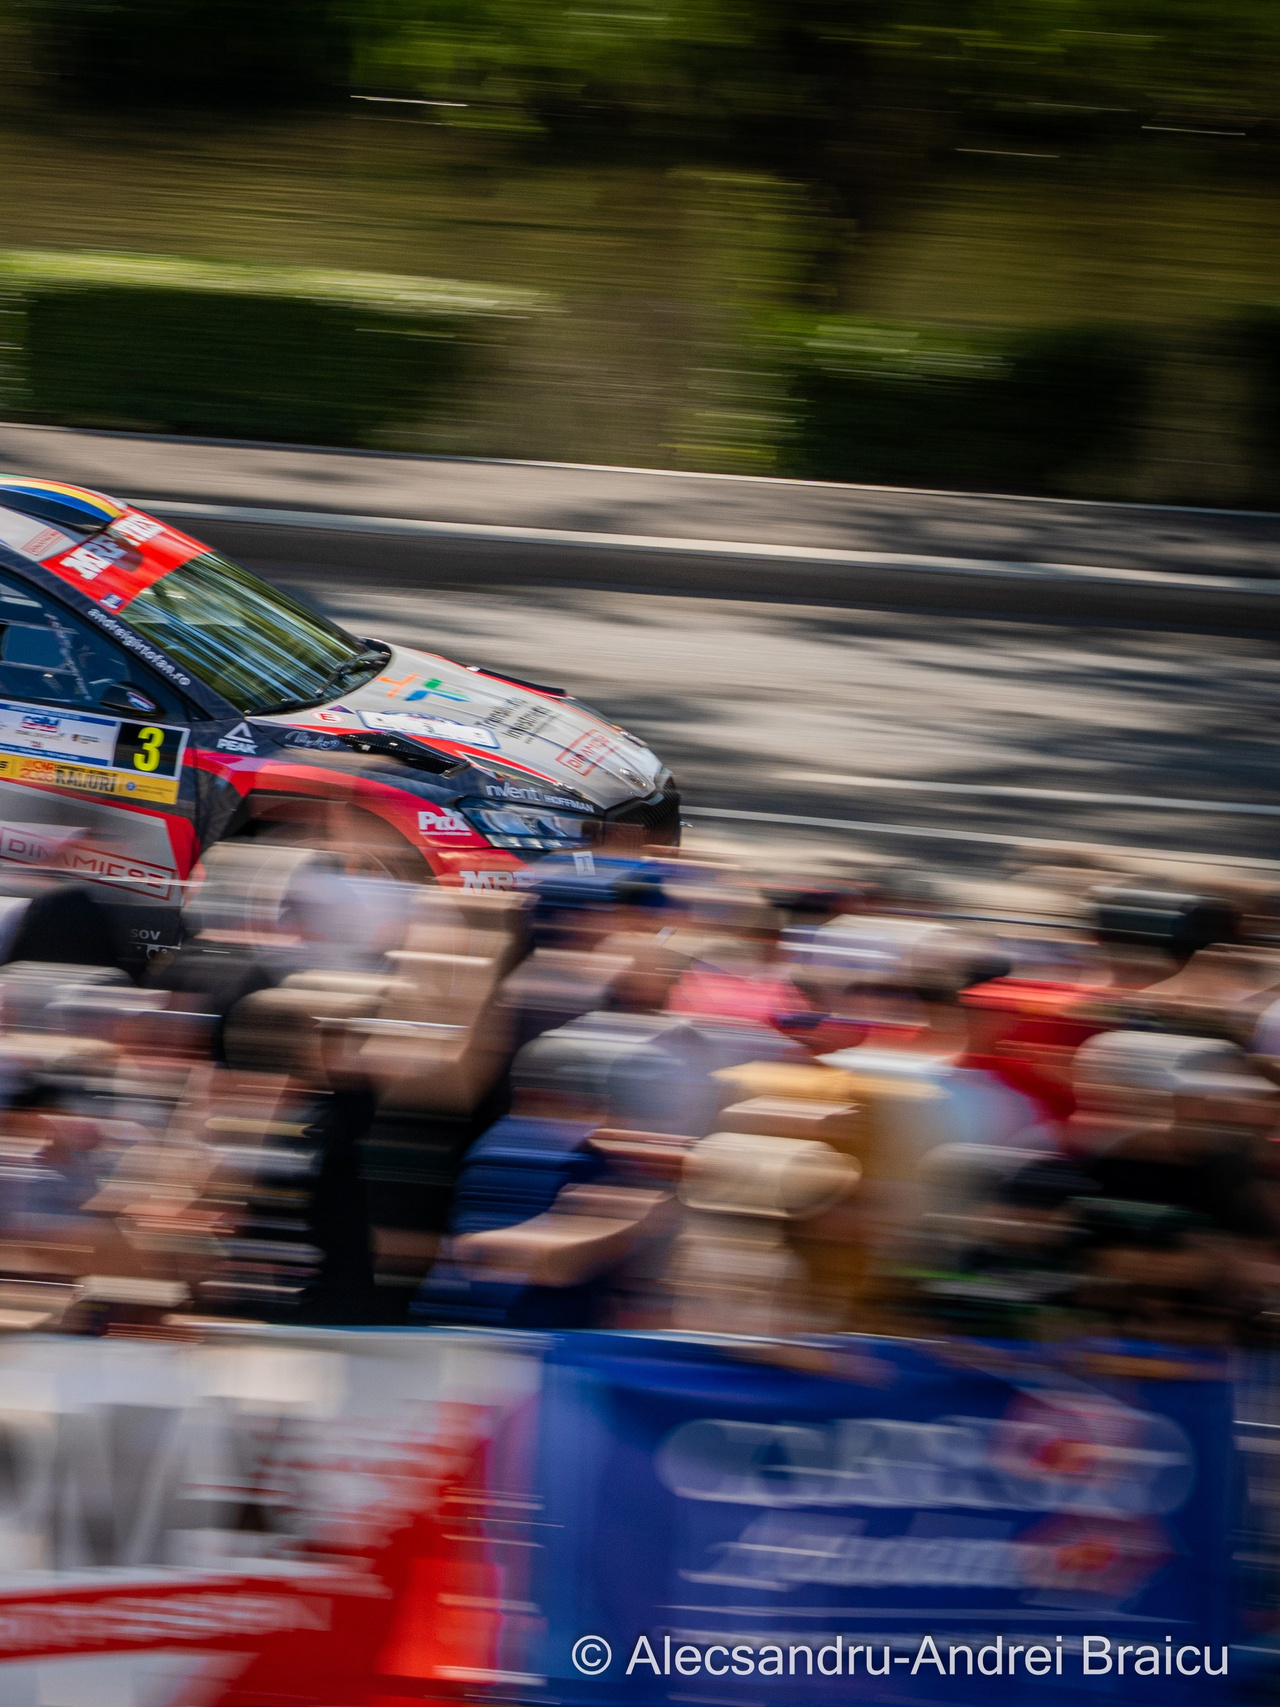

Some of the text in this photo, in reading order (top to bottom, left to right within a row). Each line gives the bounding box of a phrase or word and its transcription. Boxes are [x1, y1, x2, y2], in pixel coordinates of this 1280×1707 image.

[133, 726, 165, 772] 3
[216, 738, 259, 755] PEAK
[130, 928, 161, 941] SOV
